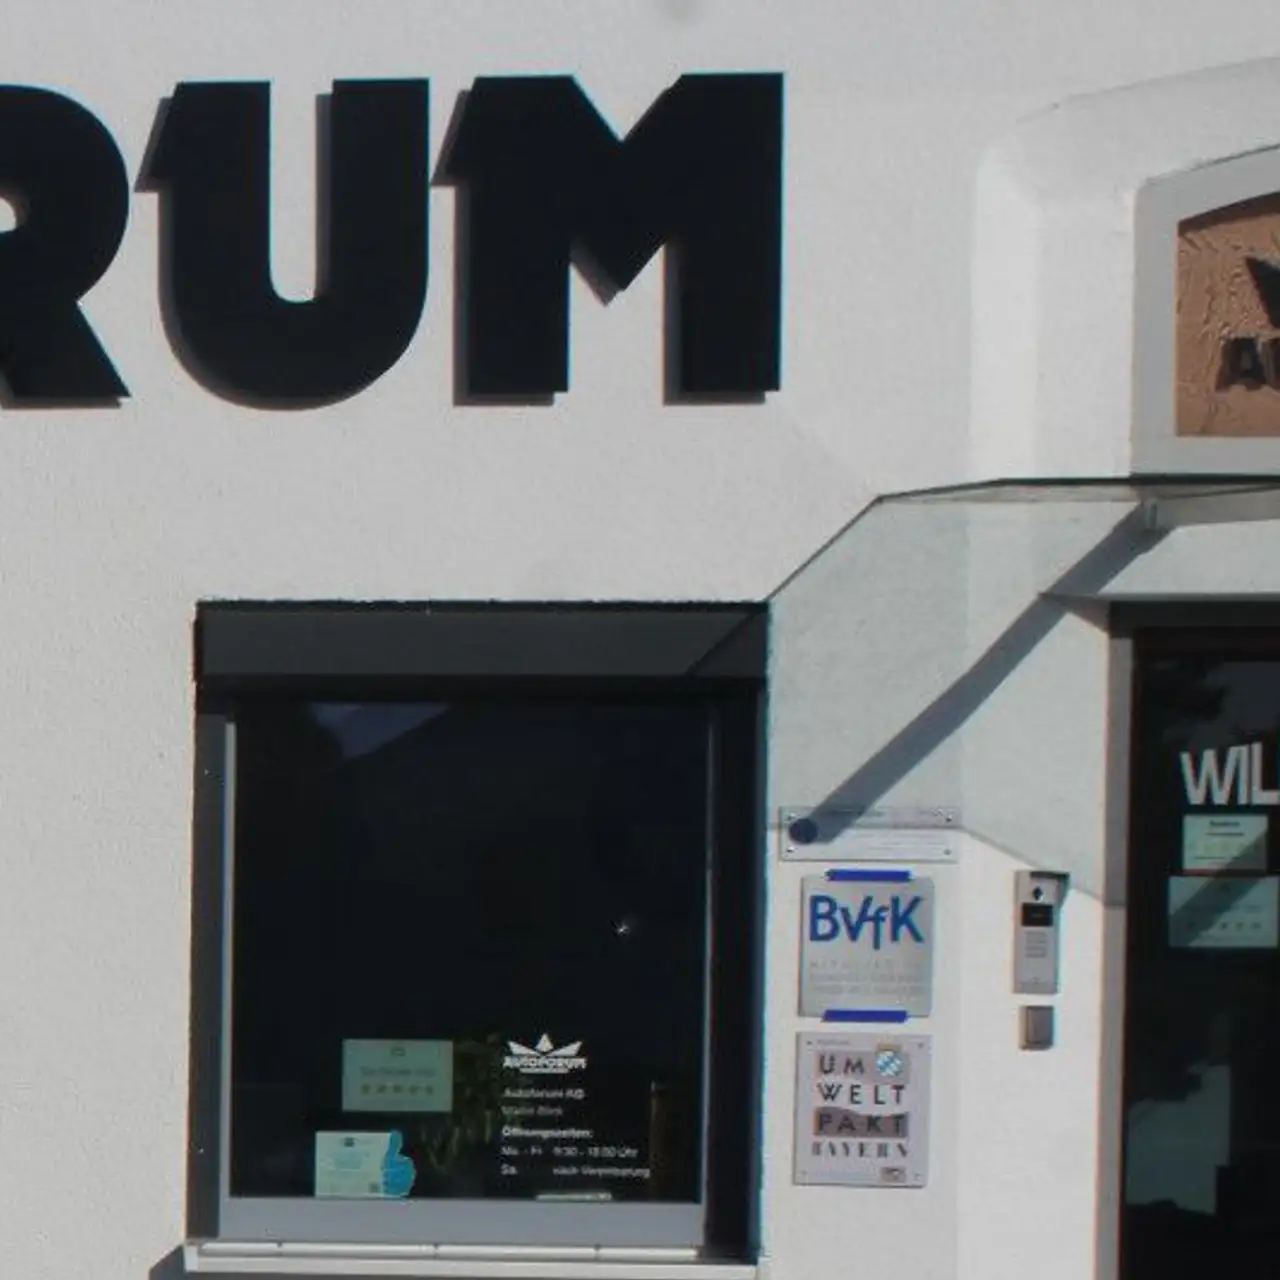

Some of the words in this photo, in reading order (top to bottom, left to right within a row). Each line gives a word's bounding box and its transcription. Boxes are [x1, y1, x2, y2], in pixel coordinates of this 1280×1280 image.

[819, 1055, 865, 1075] UM
[816, 1083, 906, 1105] WELT
[818, 1113, 906, 1134] PAKT
[811, 1141, 908, 1158] BAYERN
